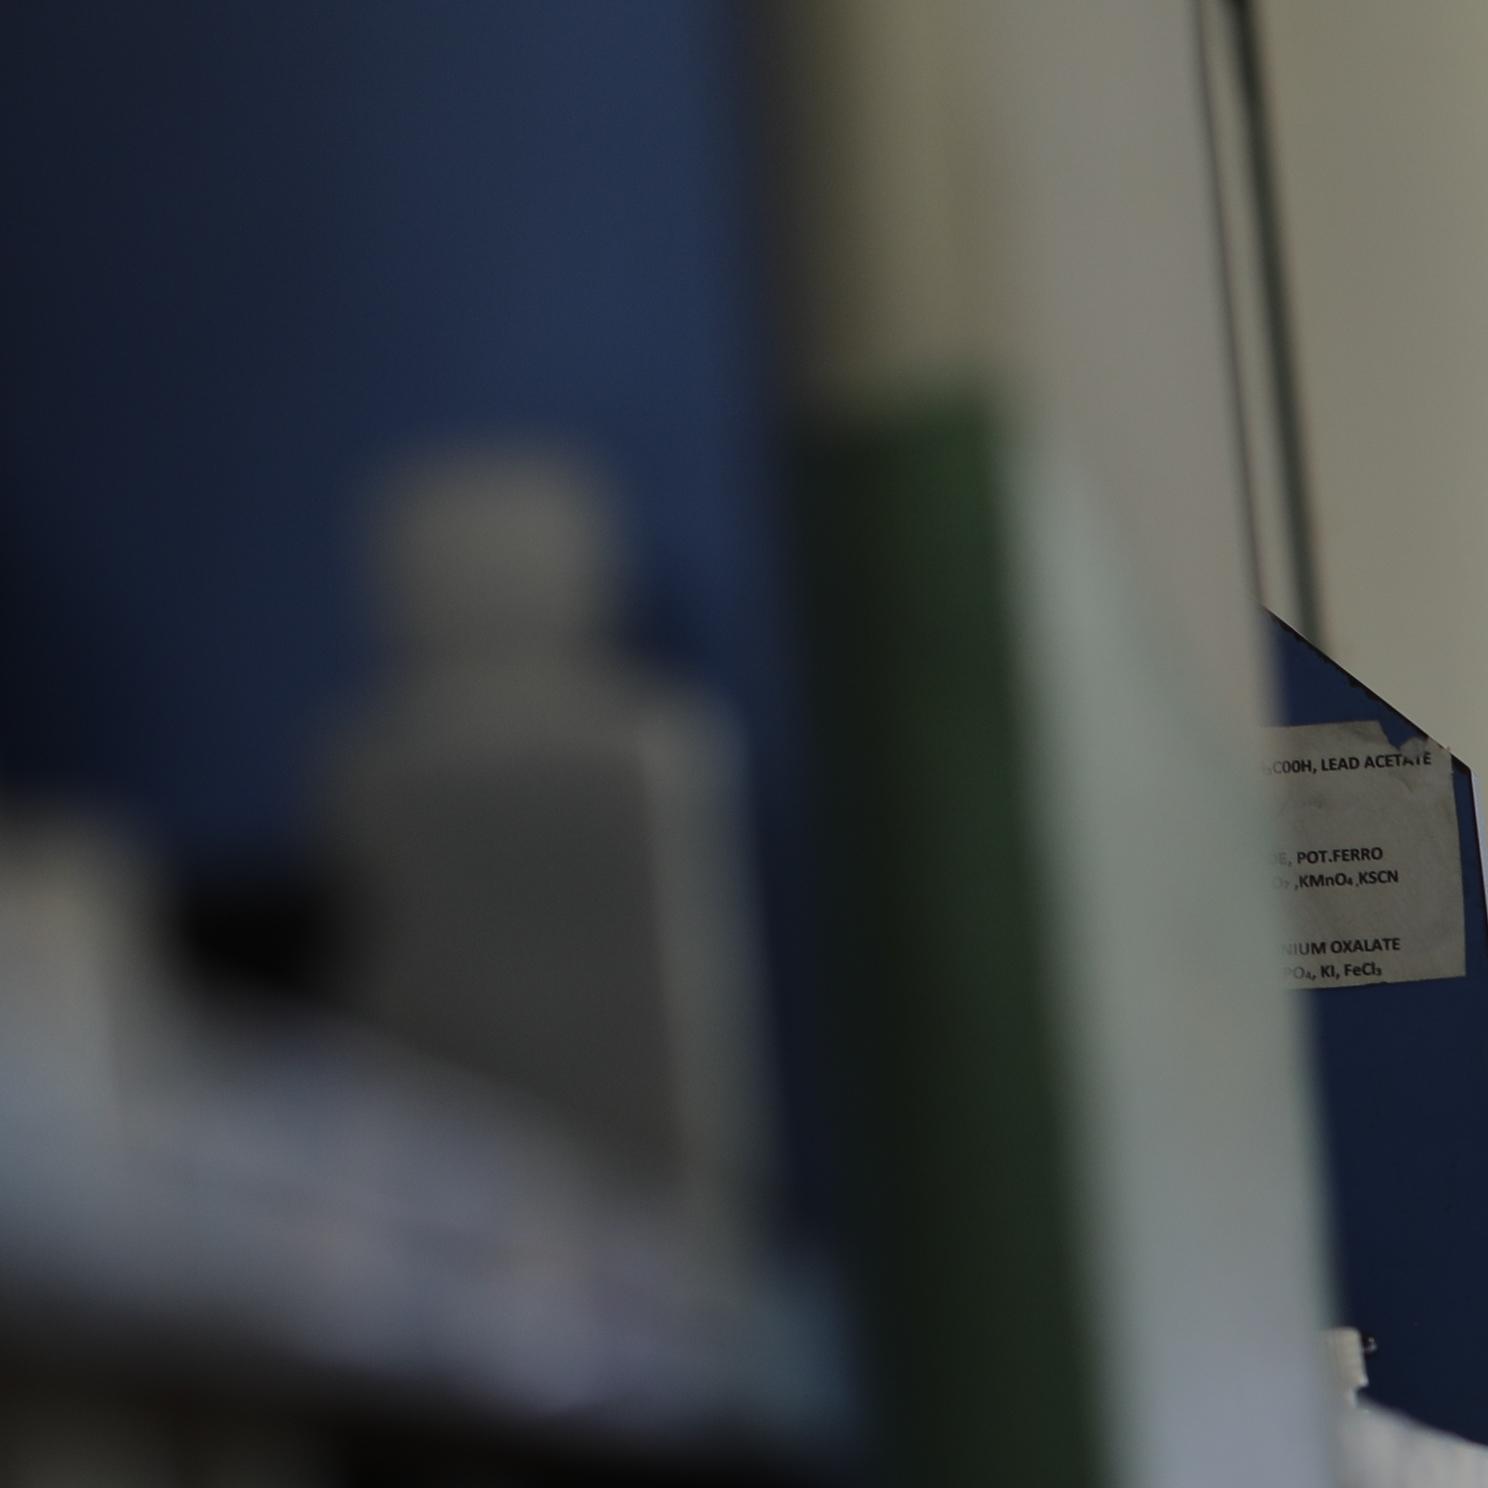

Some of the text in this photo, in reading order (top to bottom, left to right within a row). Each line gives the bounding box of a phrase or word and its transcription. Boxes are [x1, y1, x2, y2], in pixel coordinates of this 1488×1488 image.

[1321, 757, 1360, 772] LEAD
[1364, 752, 1432, 769] ACETATE
[1297, 847, 1384, 865] POT.FERRO
[1330, 937, 1401, 954] OXALATE
